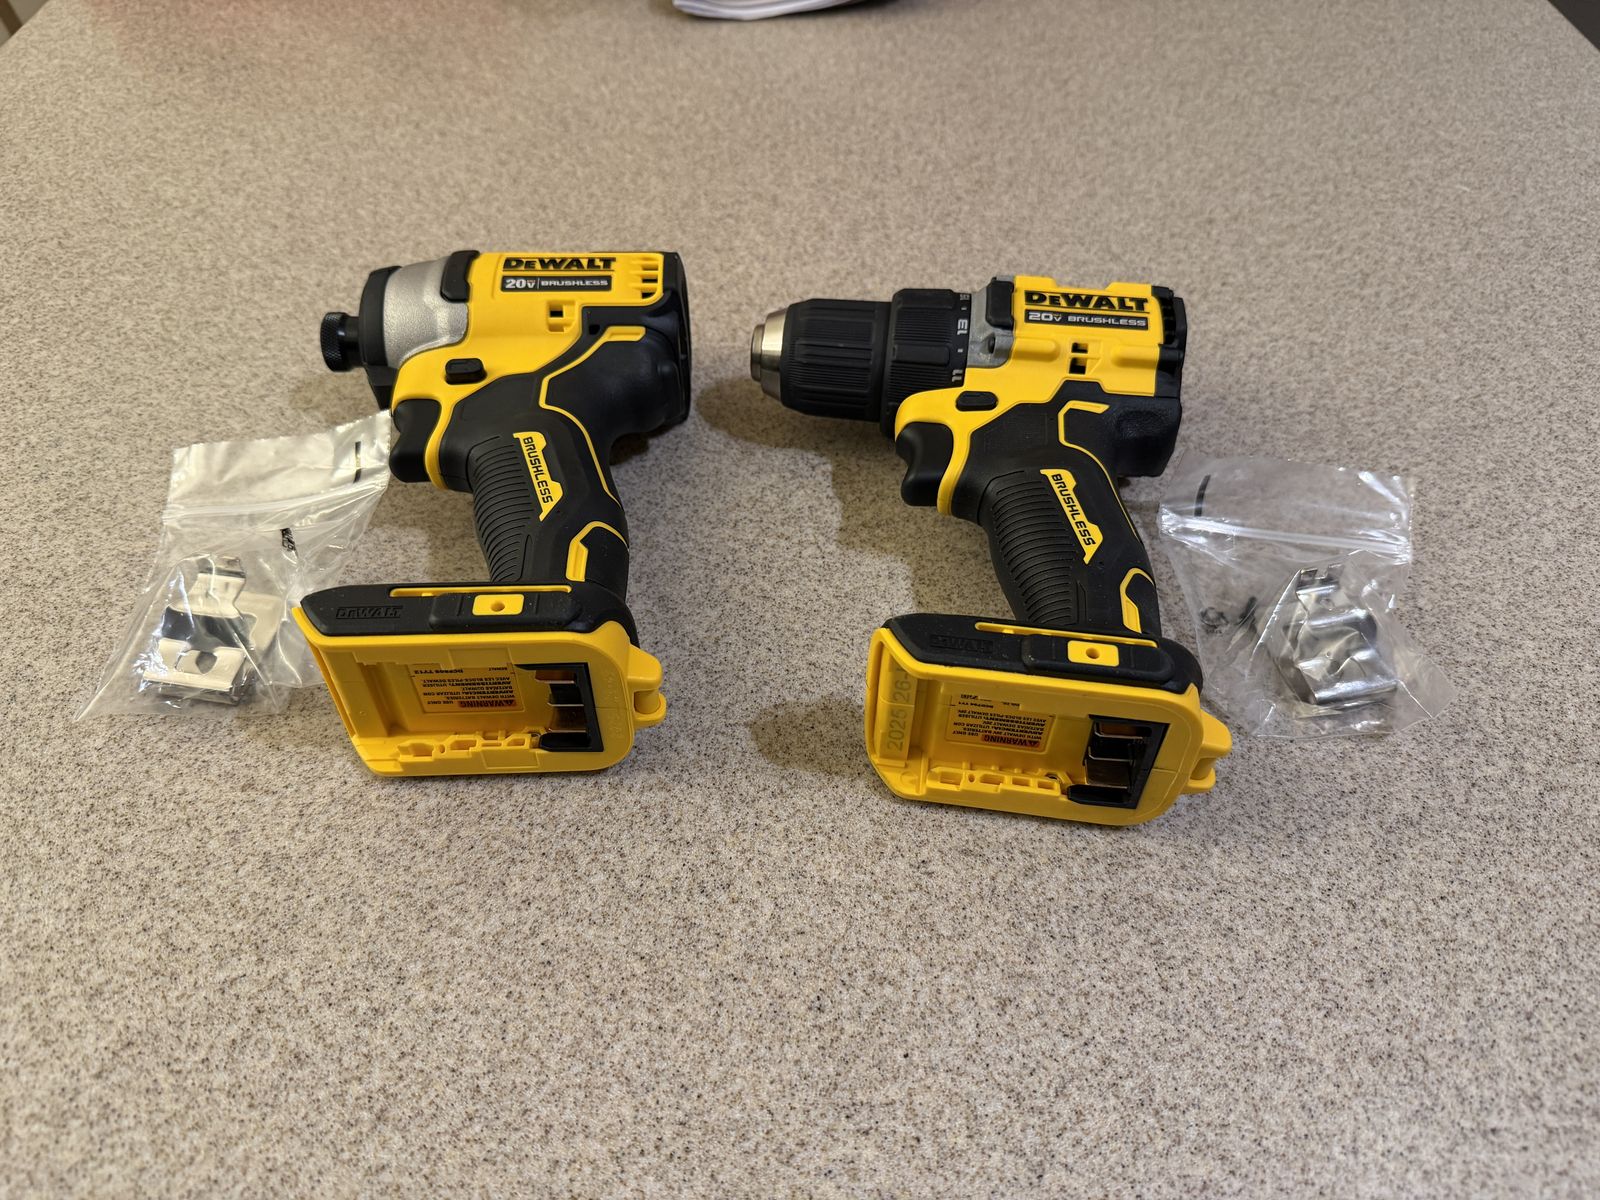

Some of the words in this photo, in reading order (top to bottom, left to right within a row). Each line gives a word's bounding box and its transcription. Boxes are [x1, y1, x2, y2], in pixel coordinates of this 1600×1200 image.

[541, 279, 609, 287] BRUSHLESS
[957, 319, 968, 335] 13
[1067, 315, 1147, 327] BRUSHLESS
[523, 436, 554, 504] BRUSHLESS
[1051, 473, 1097, 546] BRUSHLESS
[460, 700, 504, 708] WARNING
[887, 708, 908, 752] 2025
[984, 735, 1027, 746] WARNING
